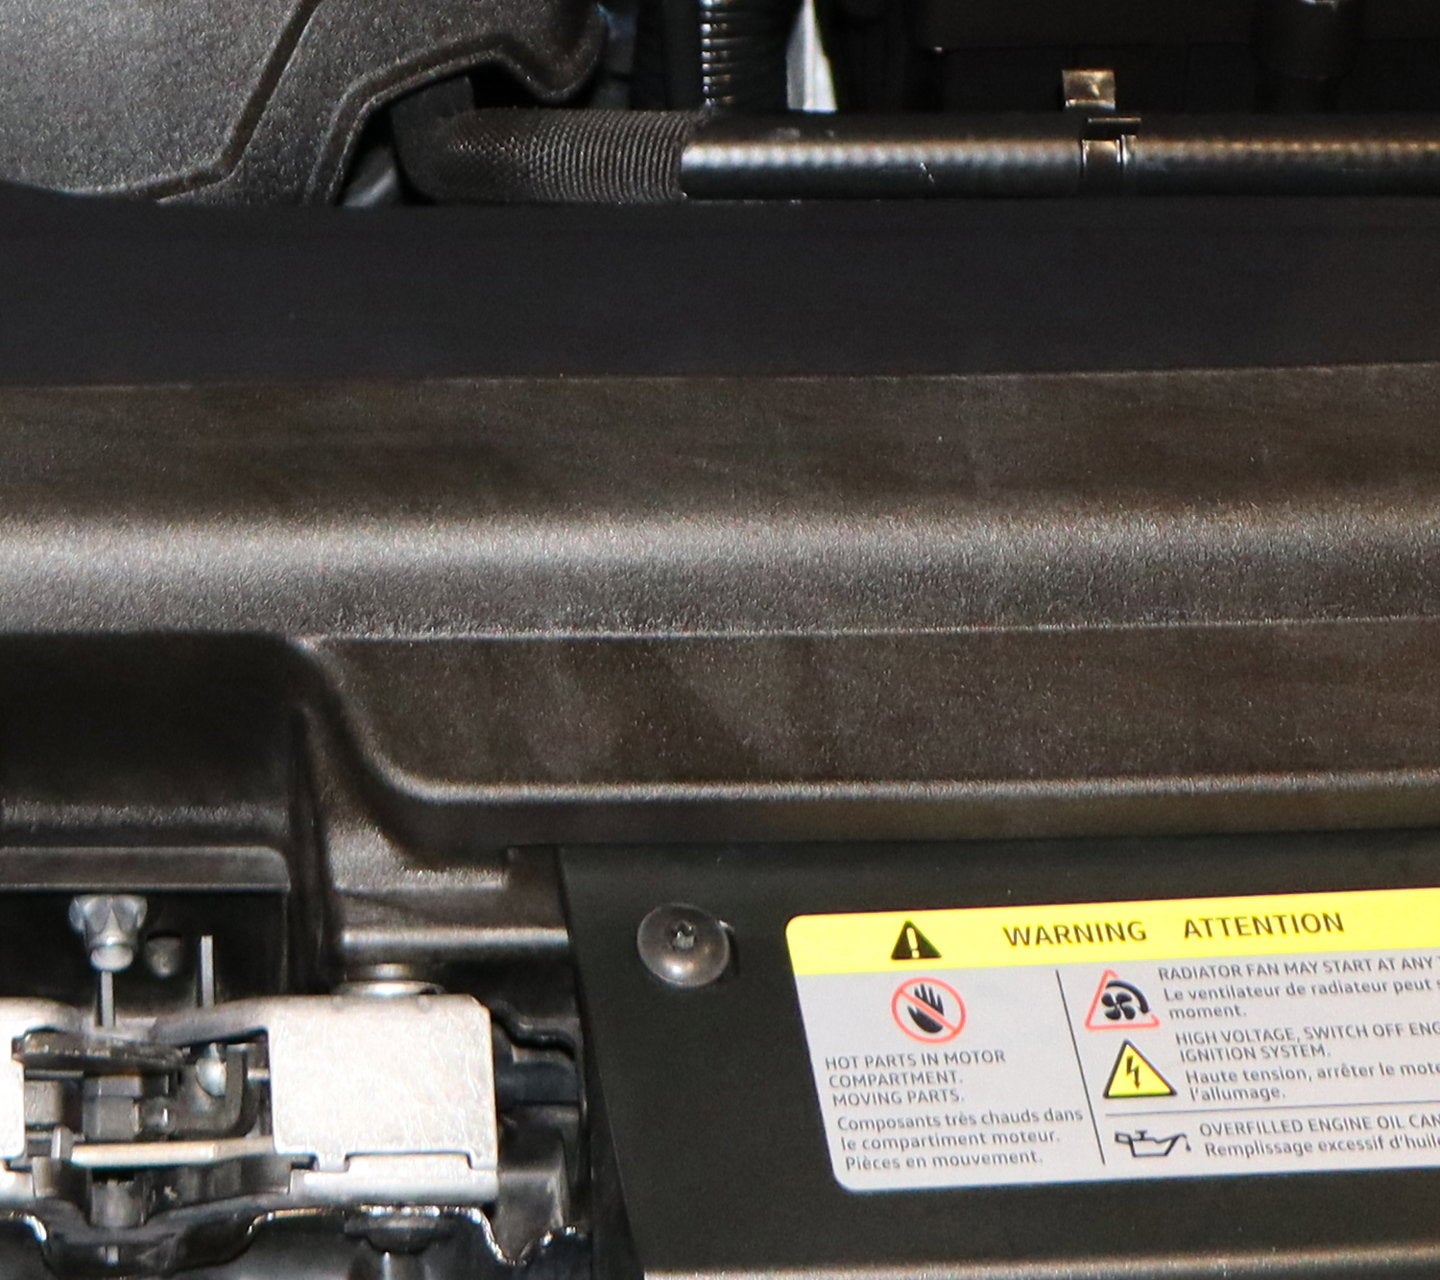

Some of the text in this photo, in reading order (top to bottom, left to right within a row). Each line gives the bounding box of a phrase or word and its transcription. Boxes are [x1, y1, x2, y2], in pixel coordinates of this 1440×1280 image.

[1002, 912, 1344, 947] WARNING ATTENTION
[1157, 963, 1243, 981] RADIATOR
[1245, 962, 1280, 977] FAN
[1283, 960, 1318, 975] MAY
[1321, 958, 1372, 974] START
[1377, 957, 1395, 971] AT
[1400, 955, 1432, 971] ANY
[1162, 987, 1183, 1002] Le
[1187, 984, 1279, 1000] ventilateur
[1284, 981, 1306, 996] de
[1310, 979, 1387, 995] radiateur
[1392, 978, 1432, 996] peut
[1168, 1003, 1246, 1020] moment.
[1174, 1030, 1218, 1046] HIGH
[1219, 1027, 1300, 1043] VOLTAGE,
[1302, 1023, 1369, 1040] SWITCH
[1371, 1022, 1403, 1038] OFF
[824, 1049, 1006, 1070] HOT PARTS IN MOTOR
[1179, 1042, 1329, 1063] IGNITION SYSTEM.
[828, 1069, 963, 1088] COMPARTMENT.
[1184, 1069, 1237, 1085] Haute
[1241, 1066, 1312, 1082] tension,
[1316, 1062, 1374, 1079] arrêter
[1377, 1061, 1395, 1076] le
[831, 1088, 964, 1107] MOVING PARTS.
[1188, 1084, 1285, 1102] l'allumage.
[836, 1106, 1083, 1134] Composants très chauds dans
[1198, 1118, 1303, 1137] OVERFILLED
[1307, 1116, 1371, 1132] ENGINE
[1376, 1115, 1403, 1130] OIL
[840, 1130, 1059, 1152] le compartiment moteur.
[1203, 1139, 1313, 1159] Remplissage
[1317, 1134, 1384, 1152] excessif
[844, 1149, 1041, 1171] Pièces en mouvement.
